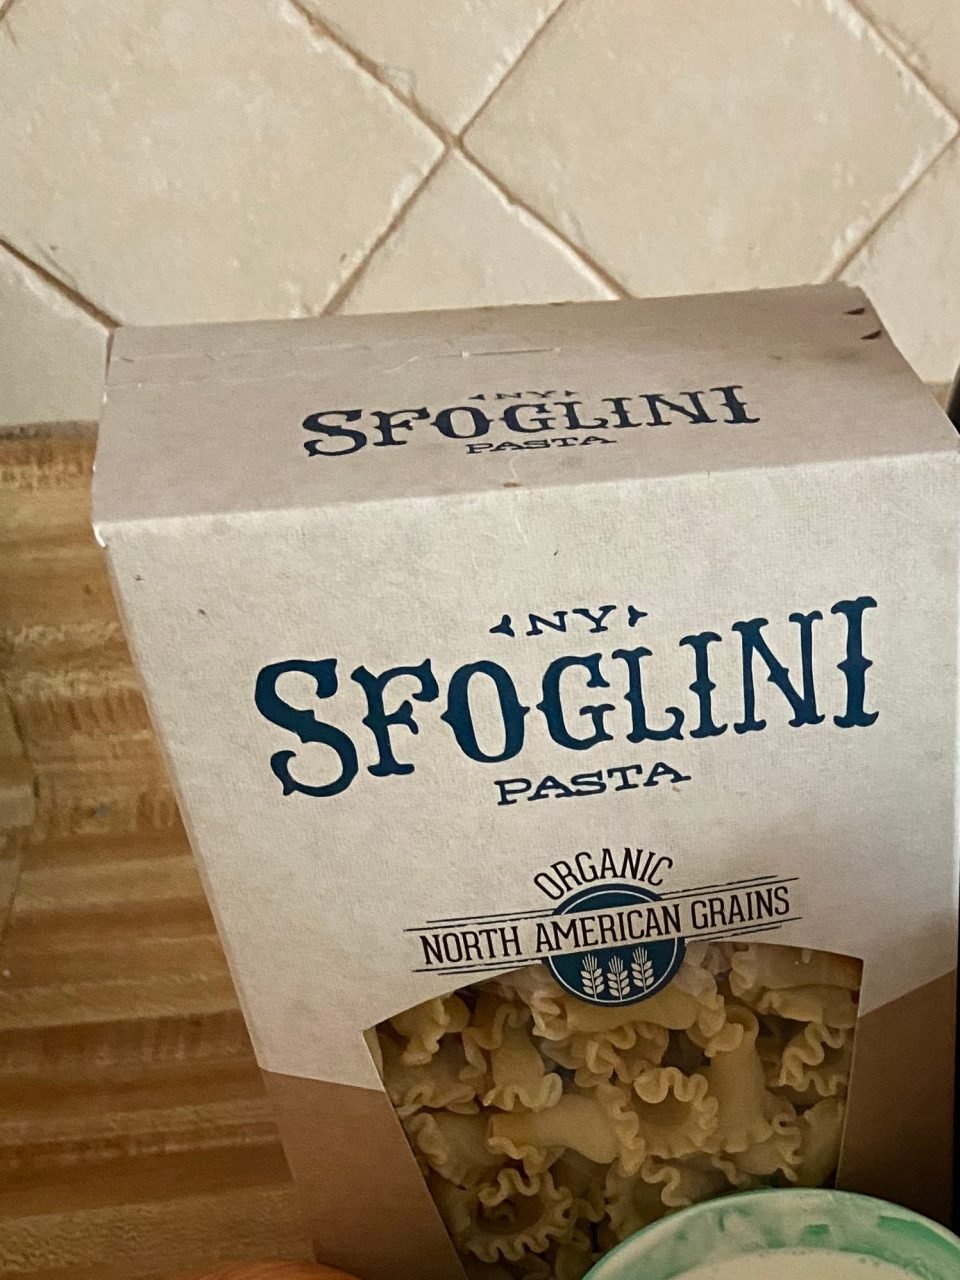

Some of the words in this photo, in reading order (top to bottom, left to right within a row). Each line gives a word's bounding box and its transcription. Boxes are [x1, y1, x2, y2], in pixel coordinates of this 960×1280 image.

[303, 385, 760, 457] SFOGLINI
[466, 434, 617, 455] PASTA
[526, 605, 618, 637] NY
[255, 596, 879, 797] SFOGLINI
[495, 762, 692, 806] PASTA
[533, 847, 673, 900] ORGANIC
[420, 926, 522, 965] NORTH
[535, 903, 682, 954] AMERICAN
[691, 885, 791, 930] GRAINS
